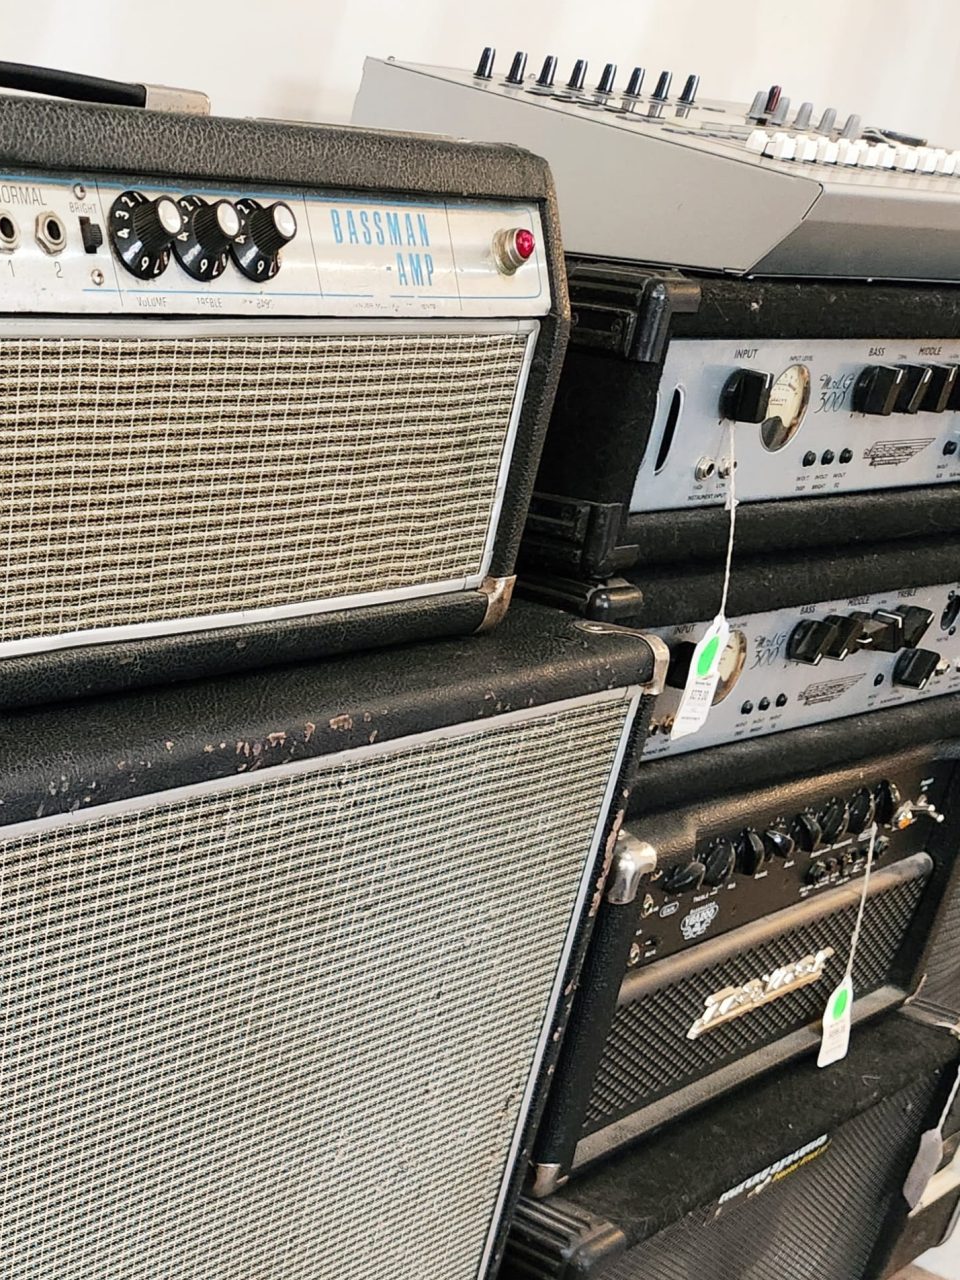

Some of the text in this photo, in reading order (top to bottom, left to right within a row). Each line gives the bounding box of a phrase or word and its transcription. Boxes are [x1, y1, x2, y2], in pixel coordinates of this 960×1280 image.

[121, 196, 136, 208] 2
[115, 210, 130, 220] 3
[116, 227, 131, 239] 4
[329, 208, 431, 248] BASSMAN
[7, 259, 15, 278] 1
[141, 256, 150, 272] 6
[200, 258, 209, 273] 6
[257, 260, 265, 274] 6
[396, 252, 434, 286] AMP
[54, 262, 64, 279] 2
[734, 348, 759, 360] INPUT
[868, 347, 886, 357] BASS
[919, 346, 943, 356] MIDDLE
[813, 391, 847, 414] 300
[848, 596, 870, 606] MIDDLE
[799, 605, 815, 615] BASS
[674, 624, 696, 635] INPUT
